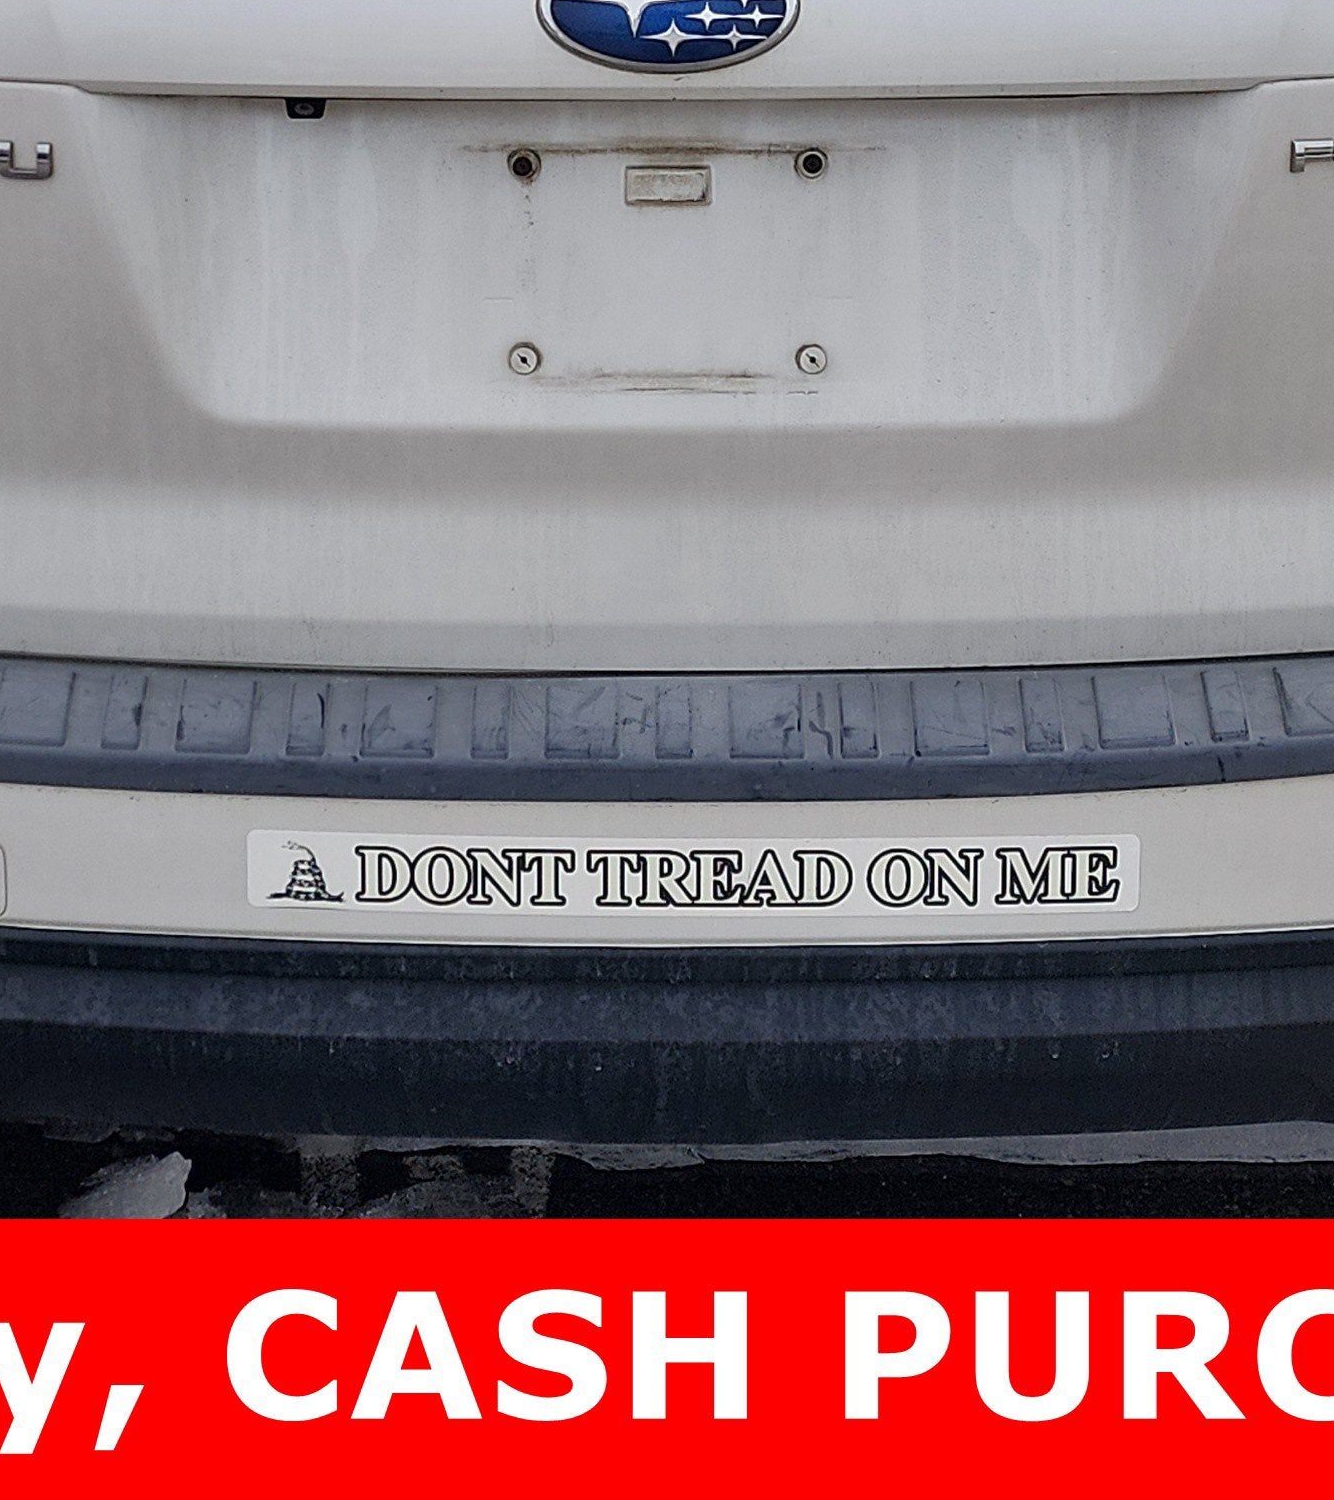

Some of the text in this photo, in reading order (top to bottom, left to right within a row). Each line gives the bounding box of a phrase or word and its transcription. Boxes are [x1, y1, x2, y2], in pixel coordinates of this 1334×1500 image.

[355, 845, 1120, 909] DONT TREAD ON ME
